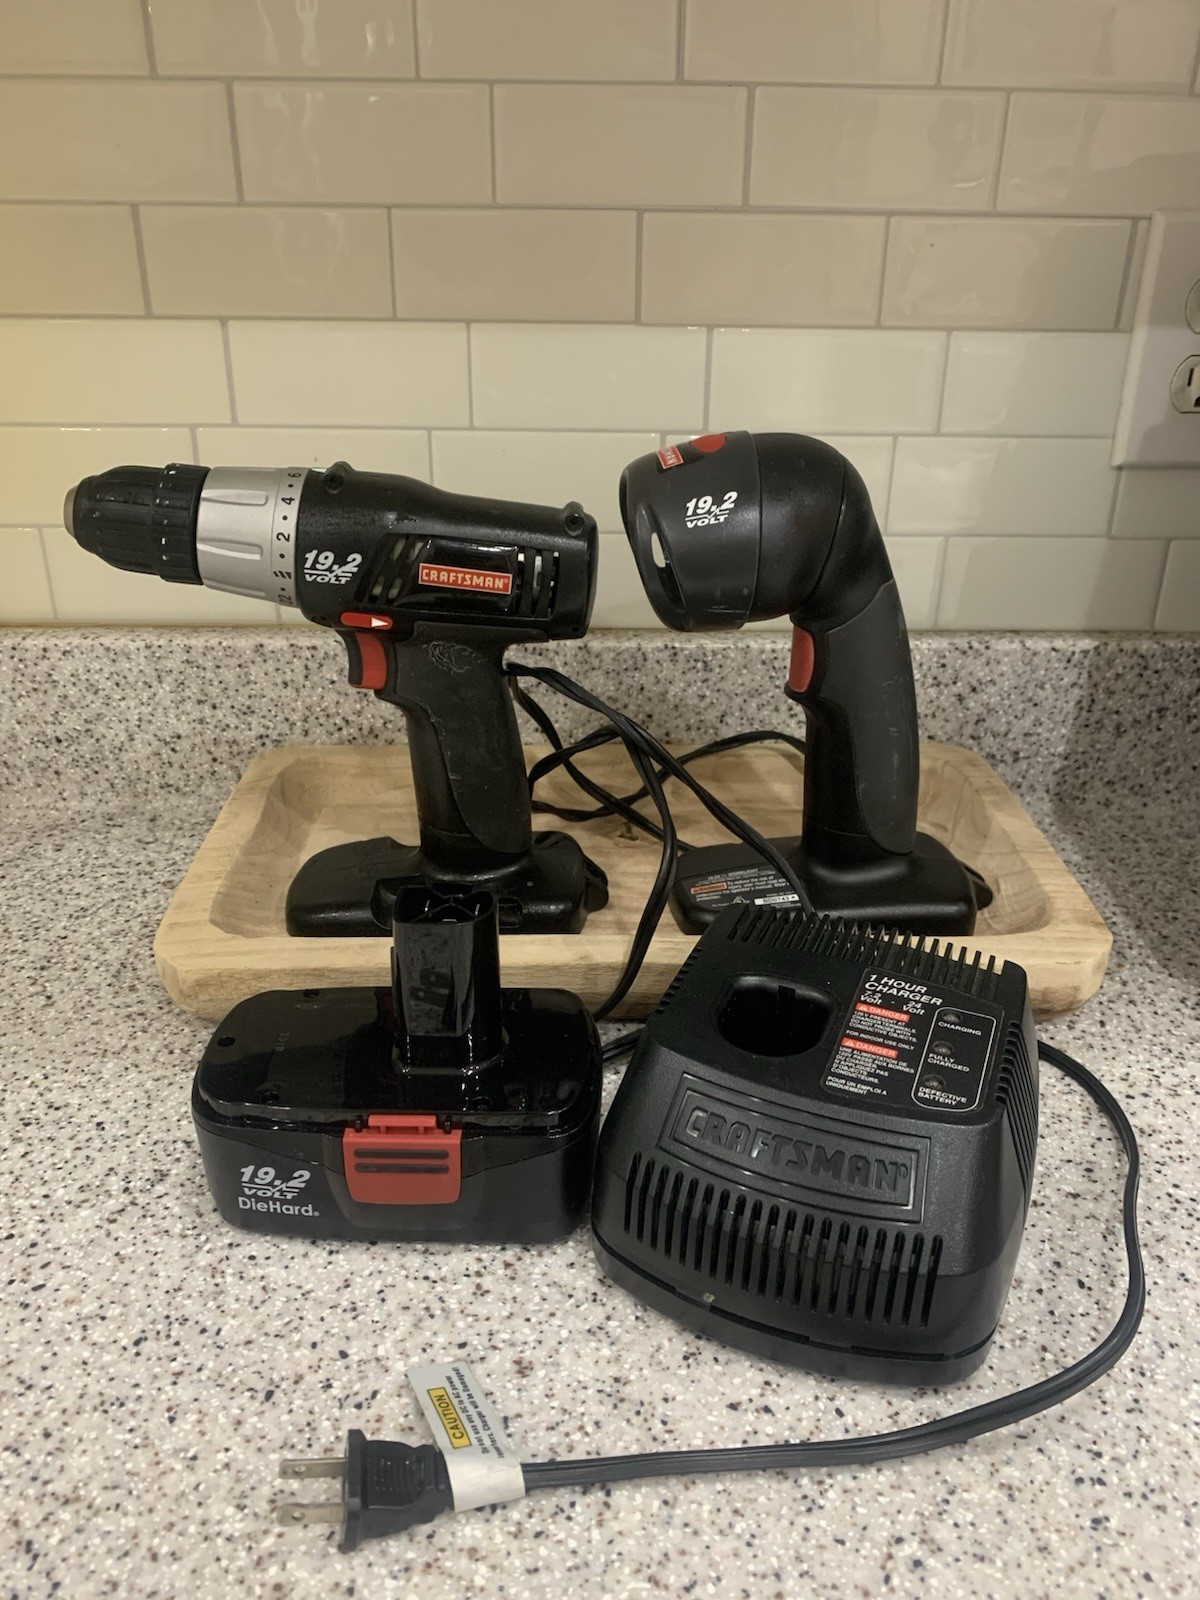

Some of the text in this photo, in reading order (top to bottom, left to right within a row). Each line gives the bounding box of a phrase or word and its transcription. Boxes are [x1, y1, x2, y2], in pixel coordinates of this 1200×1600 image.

[281, 496, 295, 505] 4
[686, 491, 738, 516] 19.2
[686, 515, 728, 528] VOLT
[276, 532, 290, 542] 2
[304, 549, 362, 572] 19.2
[305, 574, 350, 584] VOLT
[422, 569, 504, 589] CRAFTSMAN
[881, 977, 927, 994] HOUR
[865, 982, 942, 1006] CHARGER
[860, 994, 882, 1005] Volt
[903, 1005, 925, 1015] Volt
[870, 1006, 909, 1021] DANGER
[938, 1021, 982, 1036] CHARGING
[860, 1034, 883, 1043] INDOOR
[856, 1042, 895, 1057] DANGER
[928, 1057, 970, 1072] CHARGED
[929, 1053, 955, 1063] FULLY
[888, 1063, 914, 1074] BORNES
[826, 1081, 868, 1095] UNIQUEMENT
[827, 1076, 846, 1084] POUR
[856, 1084, 882, 1094] EMPLOI
[917, 1092, 957, 1106] BATTERY
[919, 1086, 967, 1103] DEFECTIVE
[685, 1106, 901, 1192] CRAFTSMAN
[240, 1165, 311, 1188] 19.2
[243, 1187, 298, 1200] VOLT
[238, 1196, 313, 1216] DieHard
[434, 1394, 464, 1440] CAUTION
